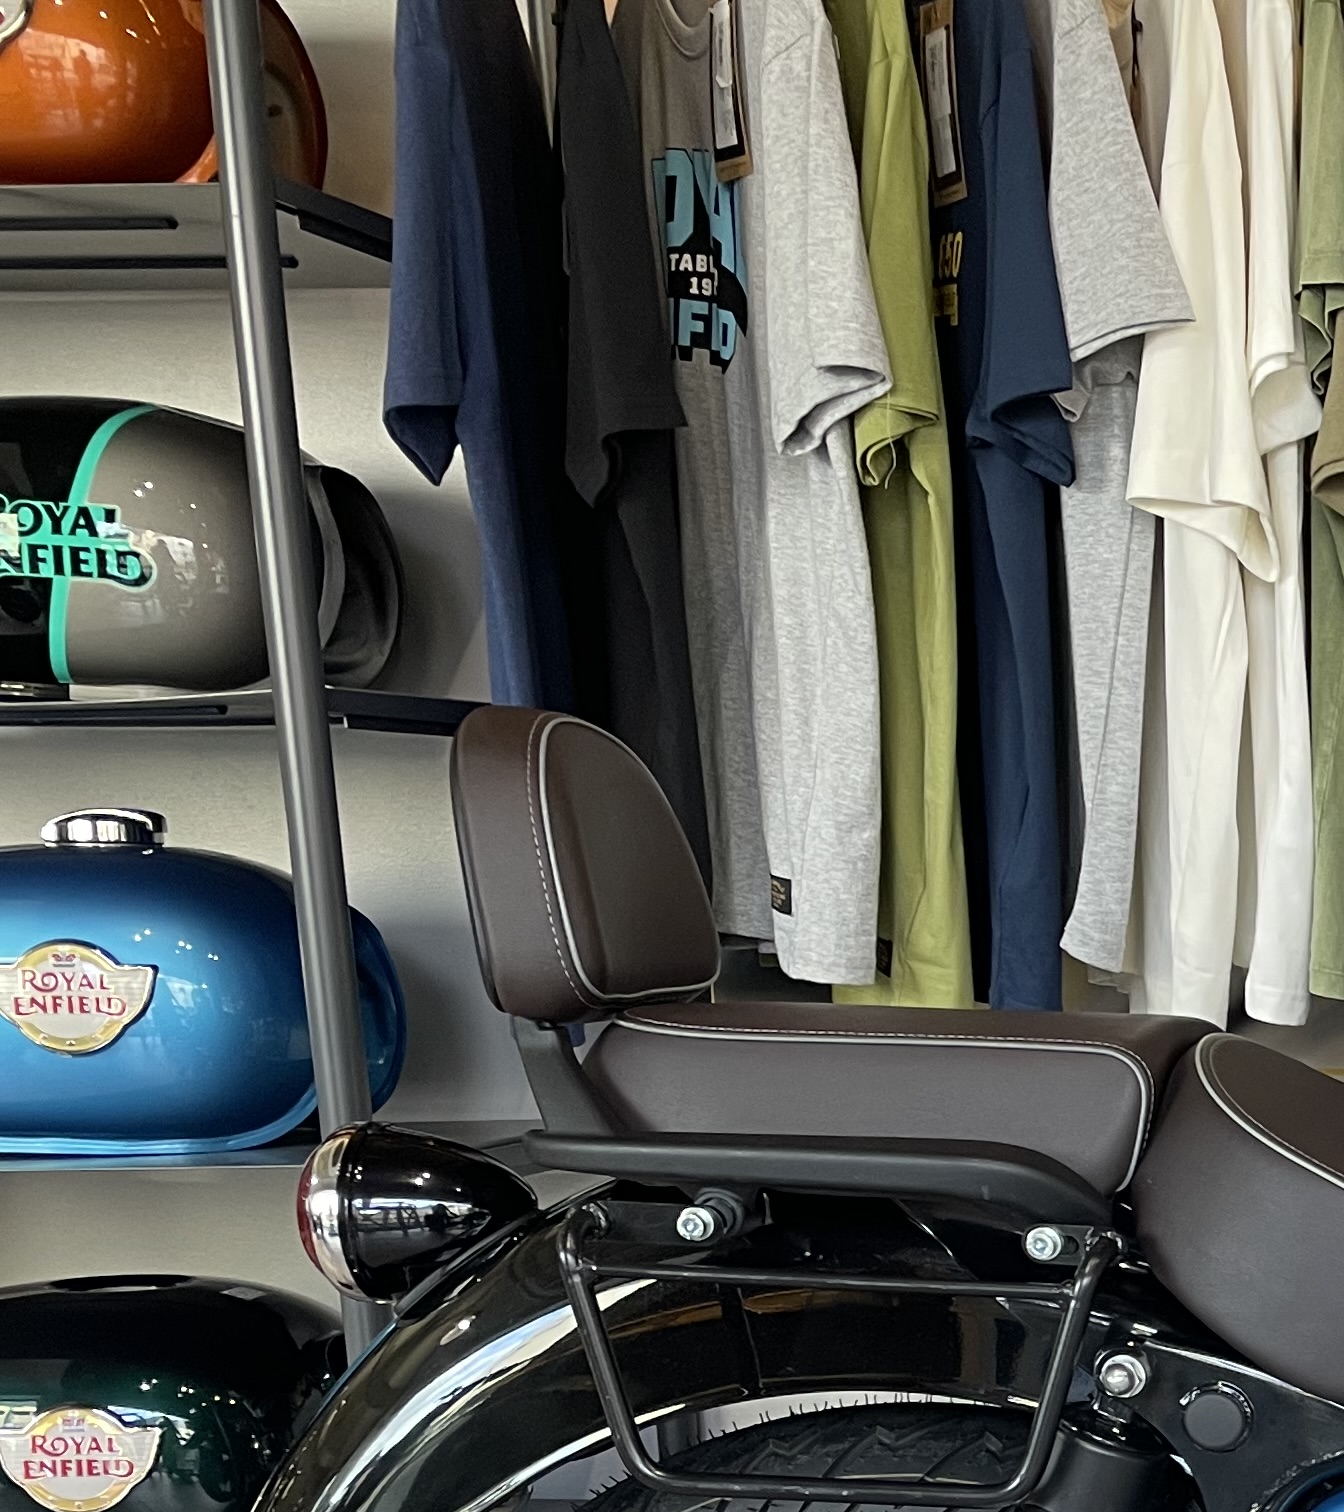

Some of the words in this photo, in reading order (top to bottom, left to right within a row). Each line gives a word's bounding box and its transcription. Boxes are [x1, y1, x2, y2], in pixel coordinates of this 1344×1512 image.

[20, 969, 114, 993] ROYAL
[13, 994, 127, 1017] ENFIELD
[31, 1434, 122, 1458] ROYAL
[22, 1459, 135, 1480] ENFIELD
